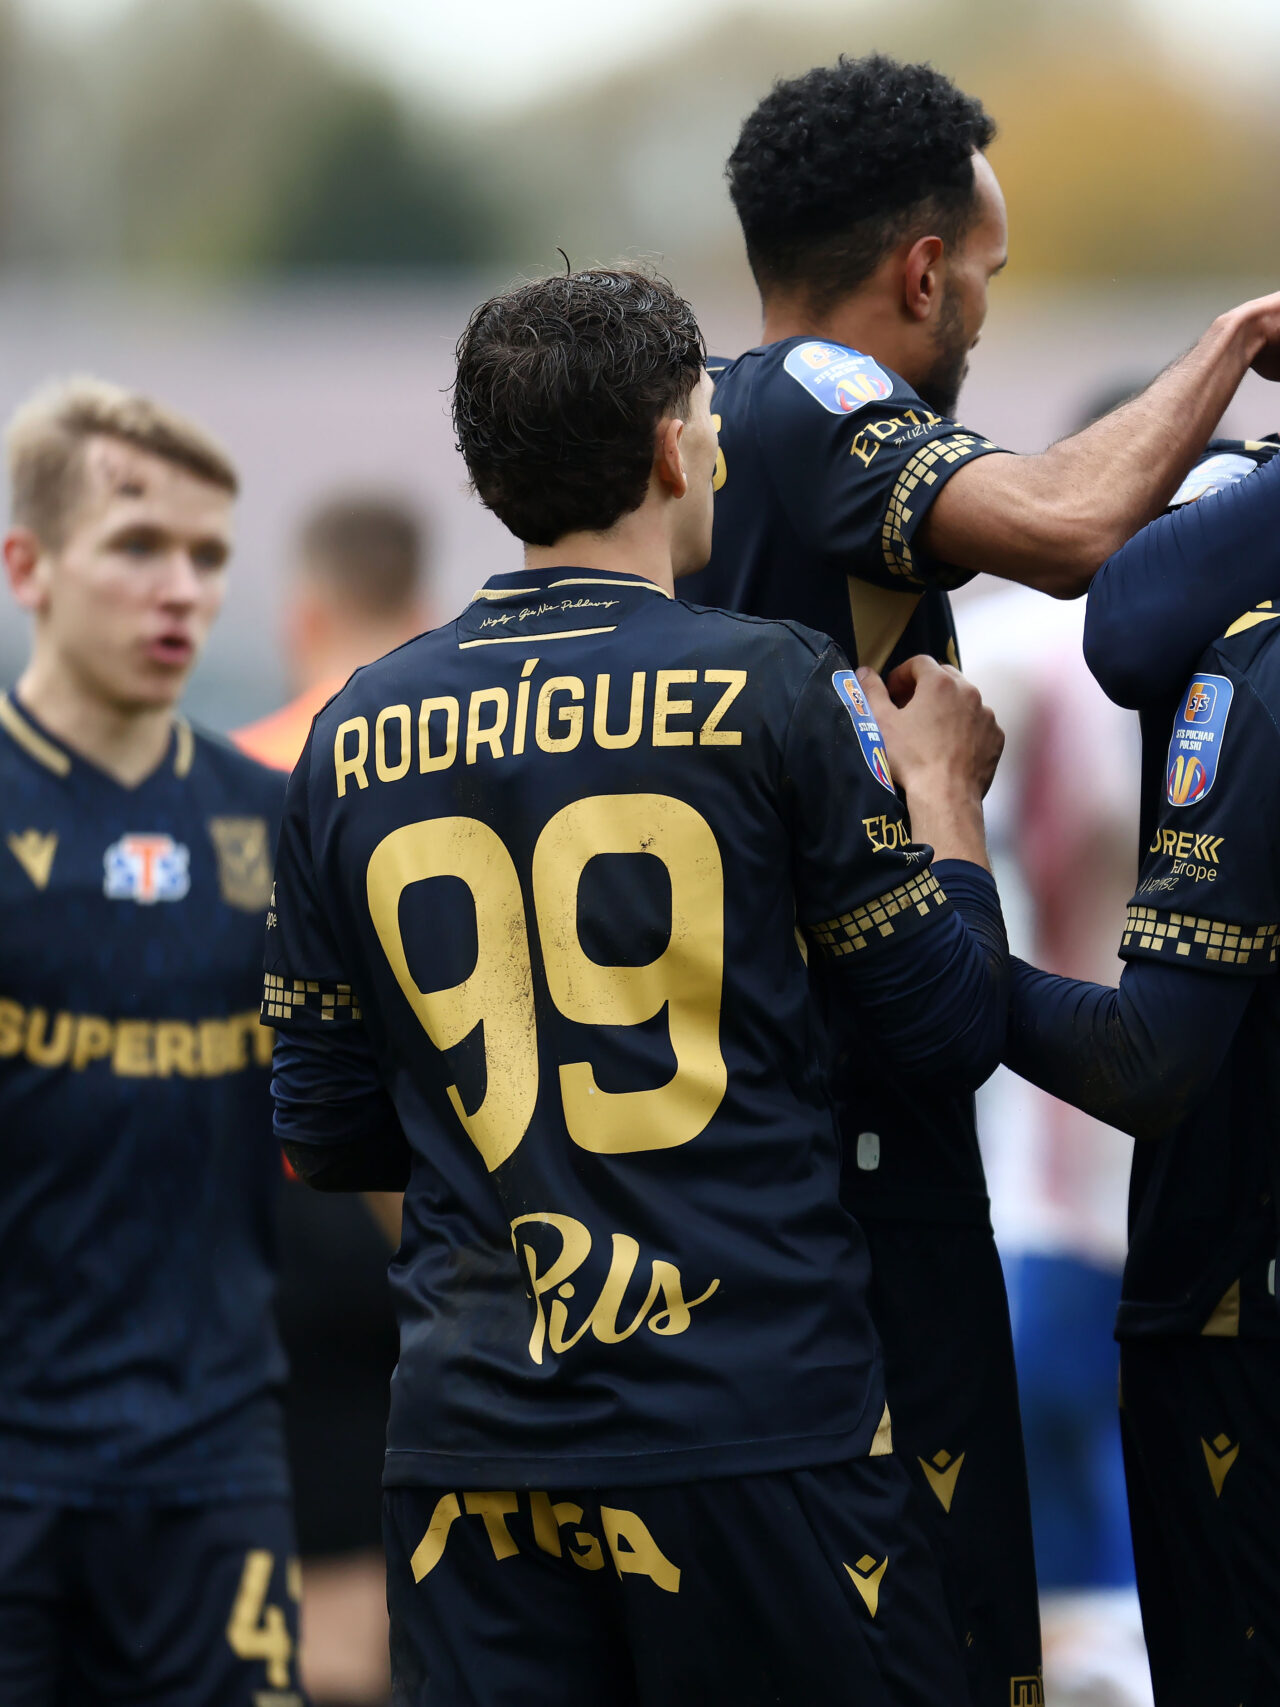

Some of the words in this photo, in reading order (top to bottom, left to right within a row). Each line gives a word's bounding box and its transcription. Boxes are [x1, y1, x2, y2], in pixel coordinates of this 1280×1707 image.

[333, 657, 748, 798] RODRÍGUEZ
[1179, 739, 1203, 752] POLSKI
[1185, 730, 1215, 743] PUCHAR
[1188, 692, 1210, 713] STS
[367, 793, 728, 1173] 99
[510, 1212, 721, 1365] Pils
[410, 1491, 681, 1594] STIGA
